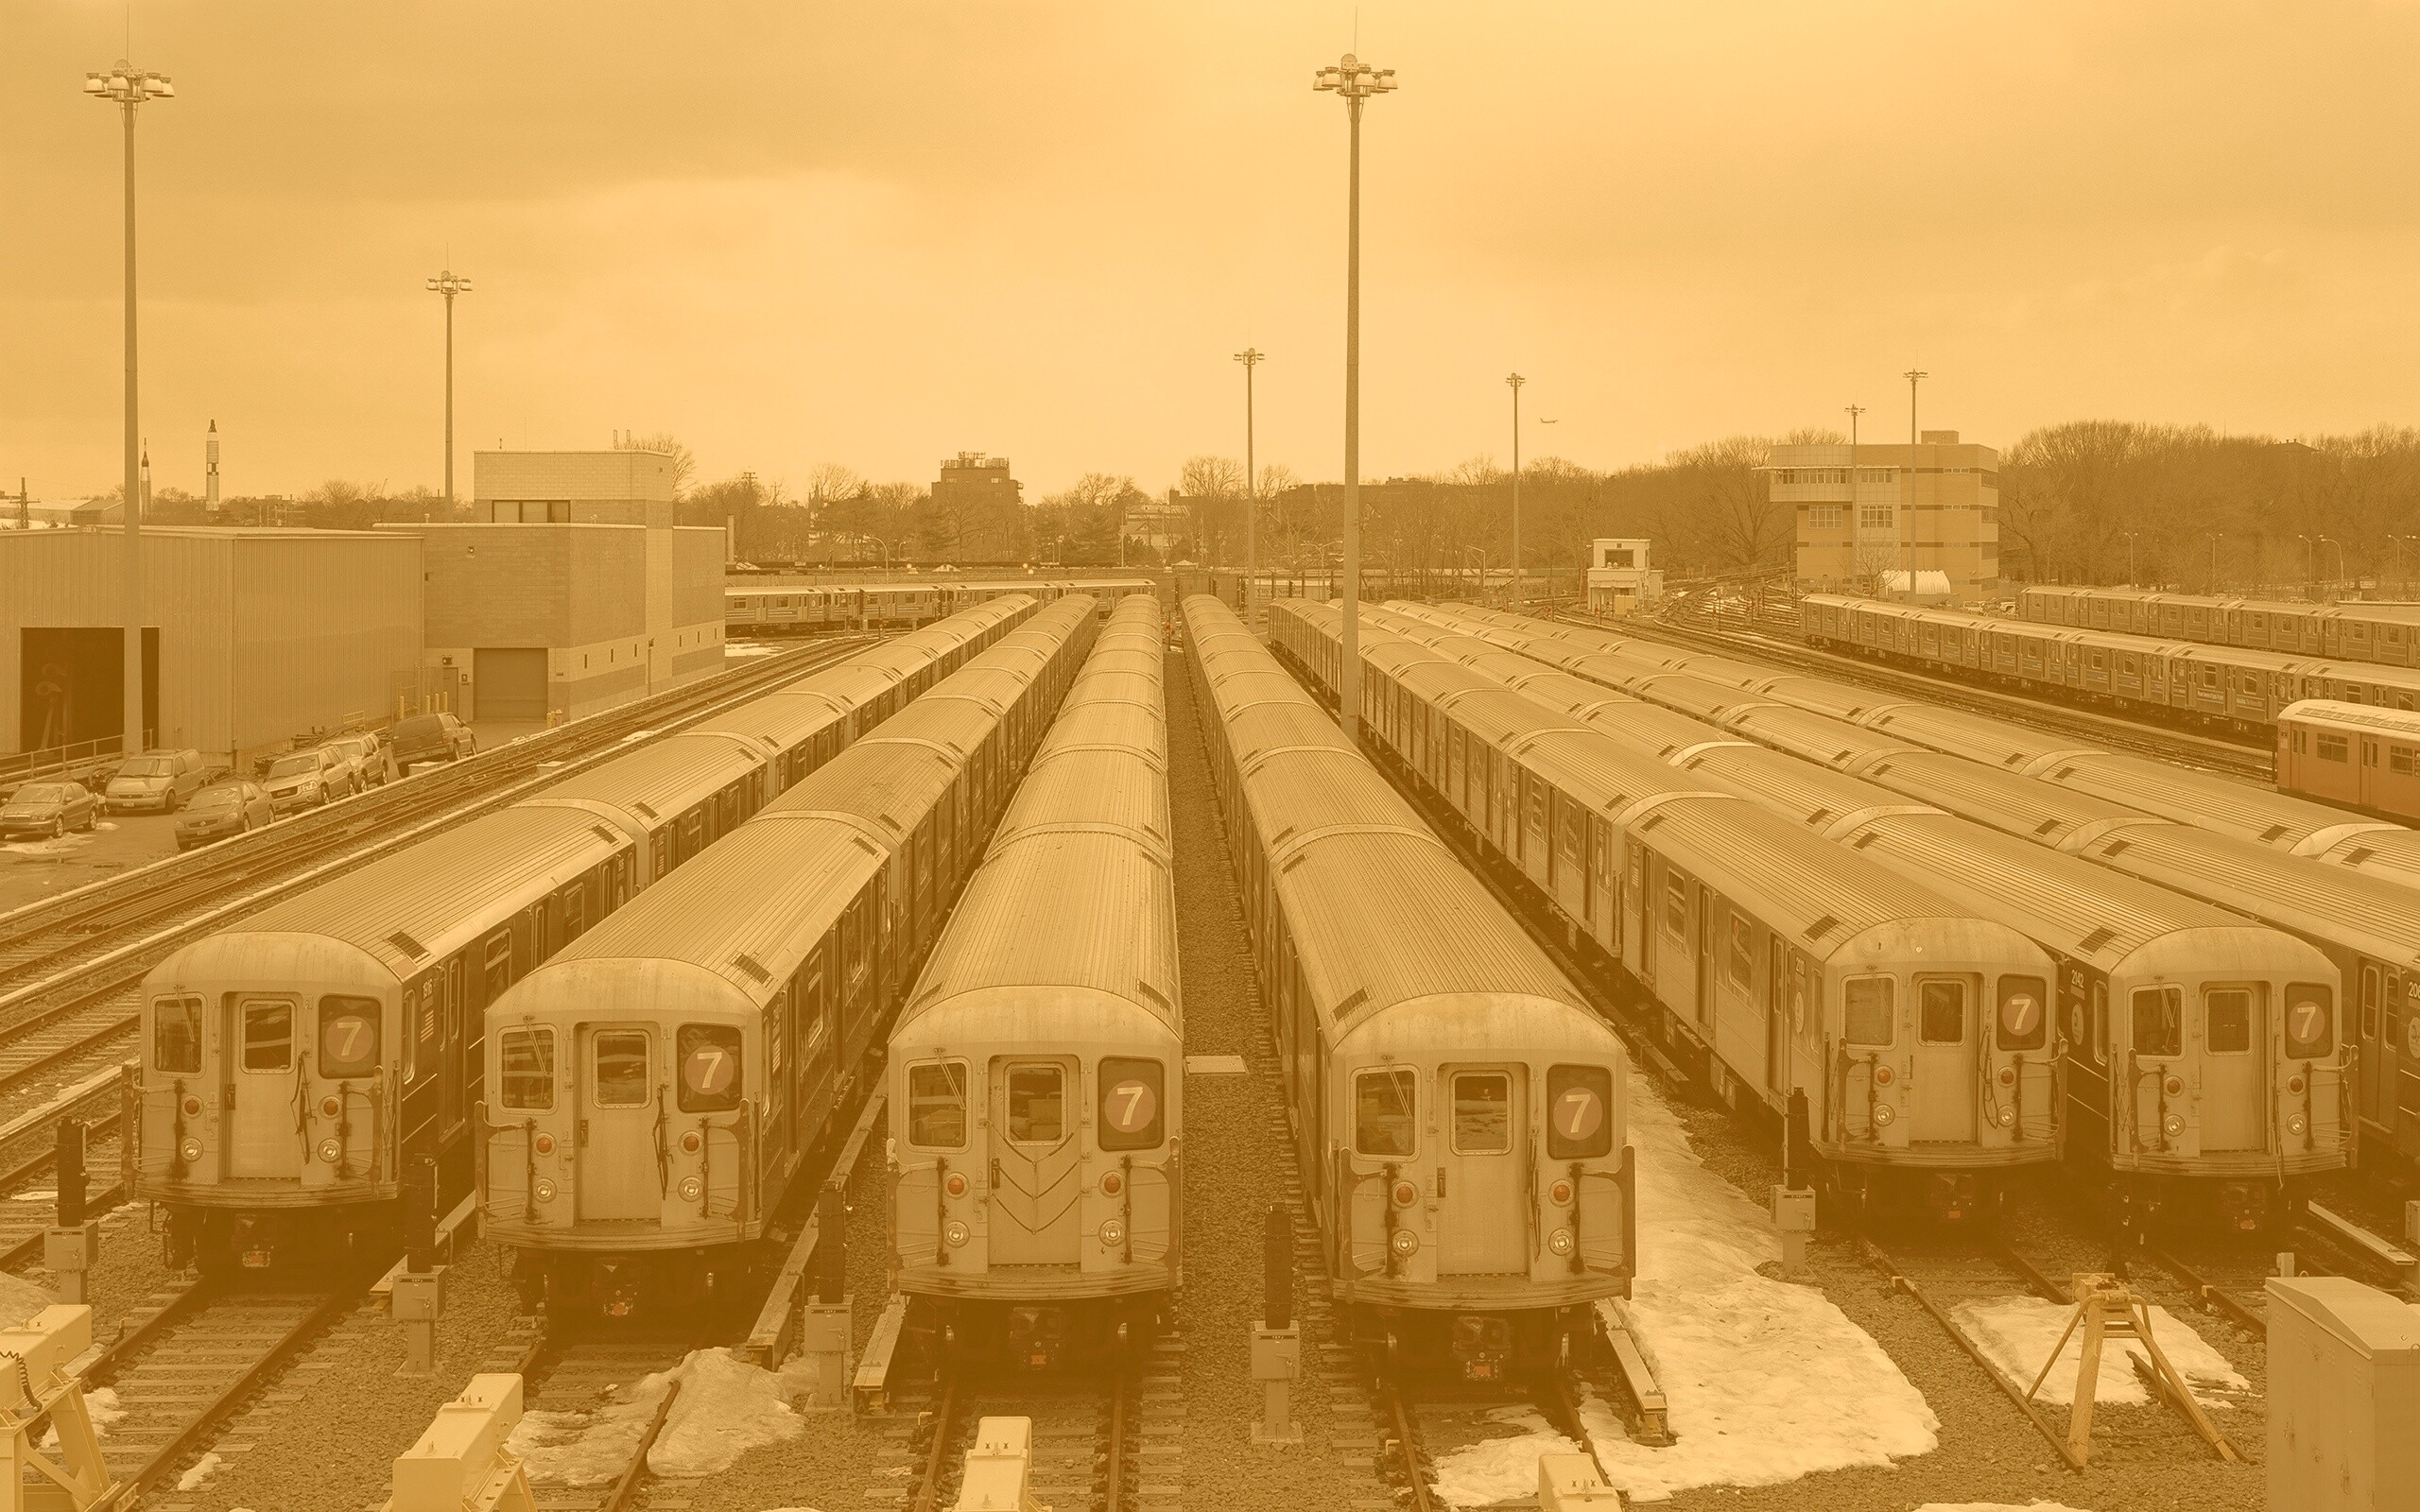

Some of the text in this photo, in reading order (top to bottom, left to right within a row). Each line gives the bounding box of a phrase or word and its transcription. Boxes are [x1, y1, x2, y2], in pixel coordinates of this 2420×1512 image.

[2071, 969, 2084, 988] 2142
[2012, 998, 2031, 1030] 7
[2297, 1006, 2316, 1039] 7
[337, 1022, 362, 1057] 7
[697, 1052, 722, 1088] 7
[1117, 1087, 1143, 1125] 7
[1565, 1093, 1591, 1133] 7
